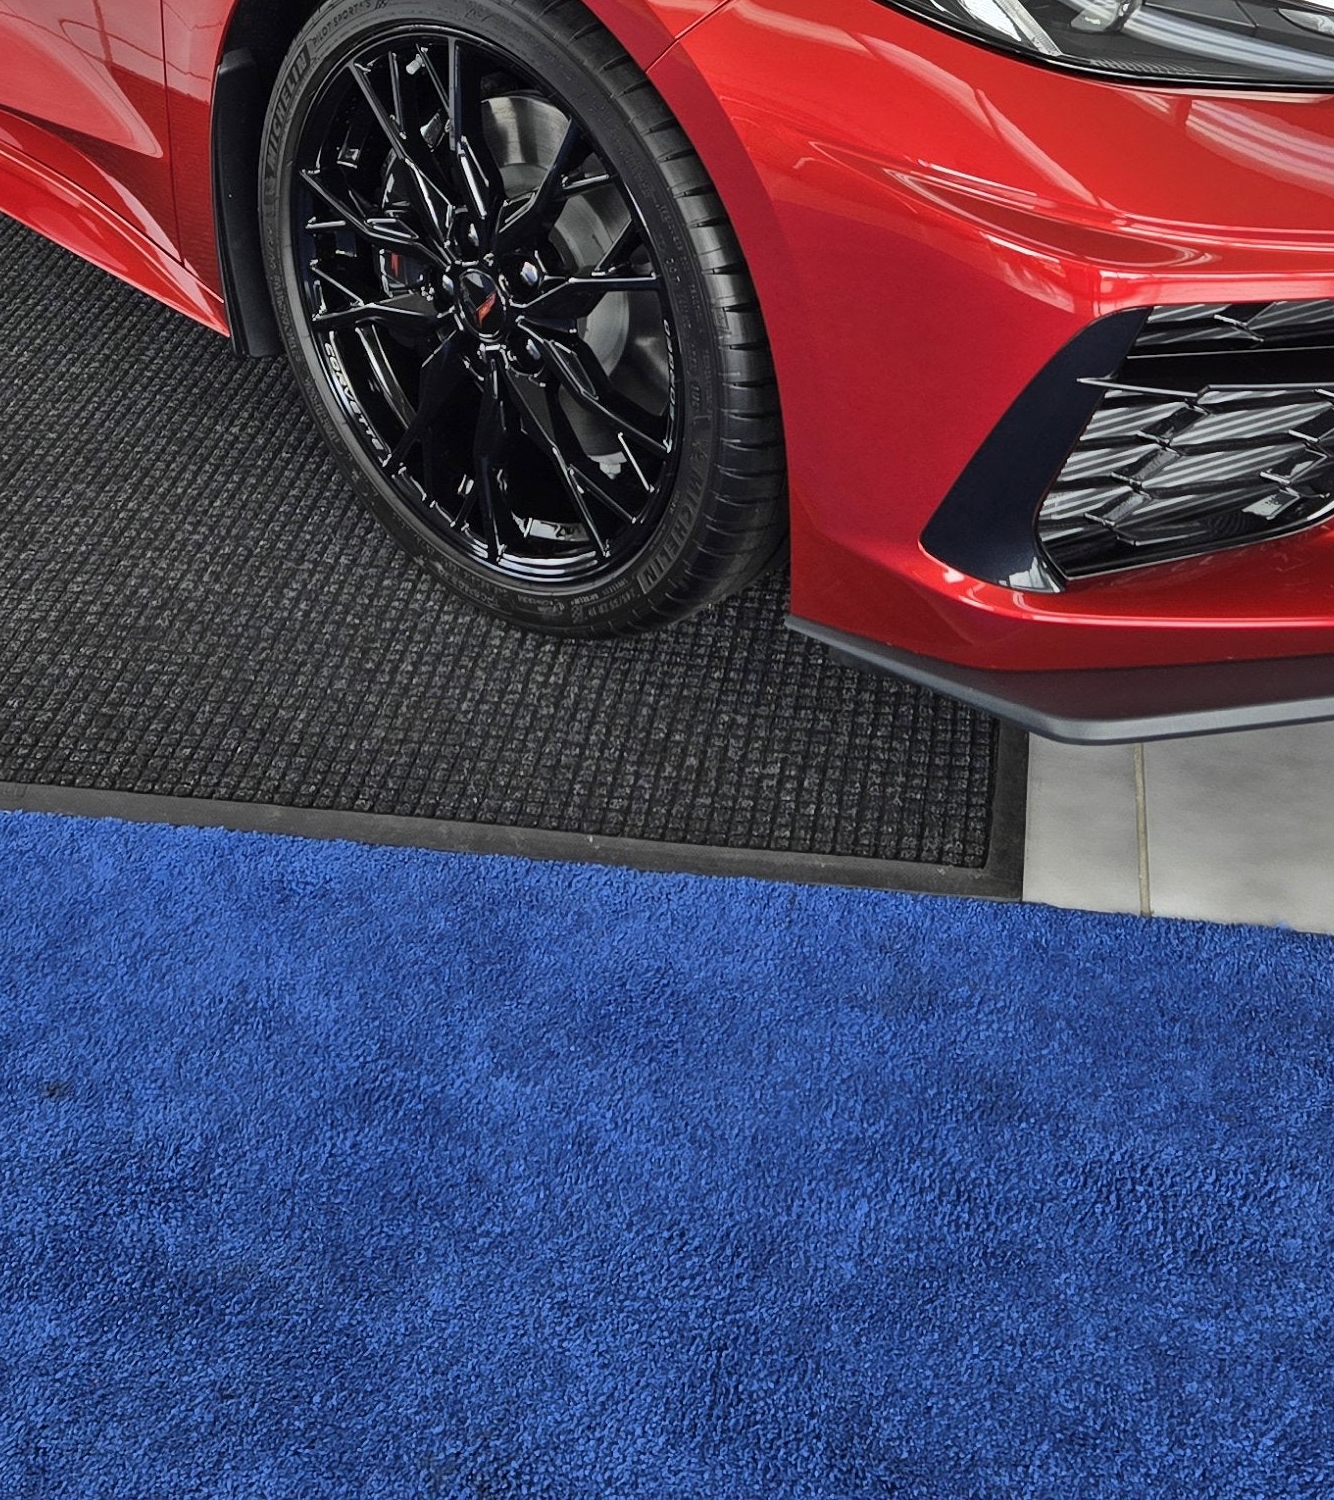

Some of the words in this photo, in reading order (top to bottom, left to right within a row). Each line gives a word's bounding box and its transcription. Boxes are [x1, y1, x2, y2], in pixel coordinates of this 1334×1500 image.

[313, 22, 333, 47] PILOT
[333, 4, 359, 27] SPORT
[267, 49, 309, 172] MICHELIN
[324, 342, 385, 450] CORVETTE
[646, 466, 705, 586] MICHELIN
